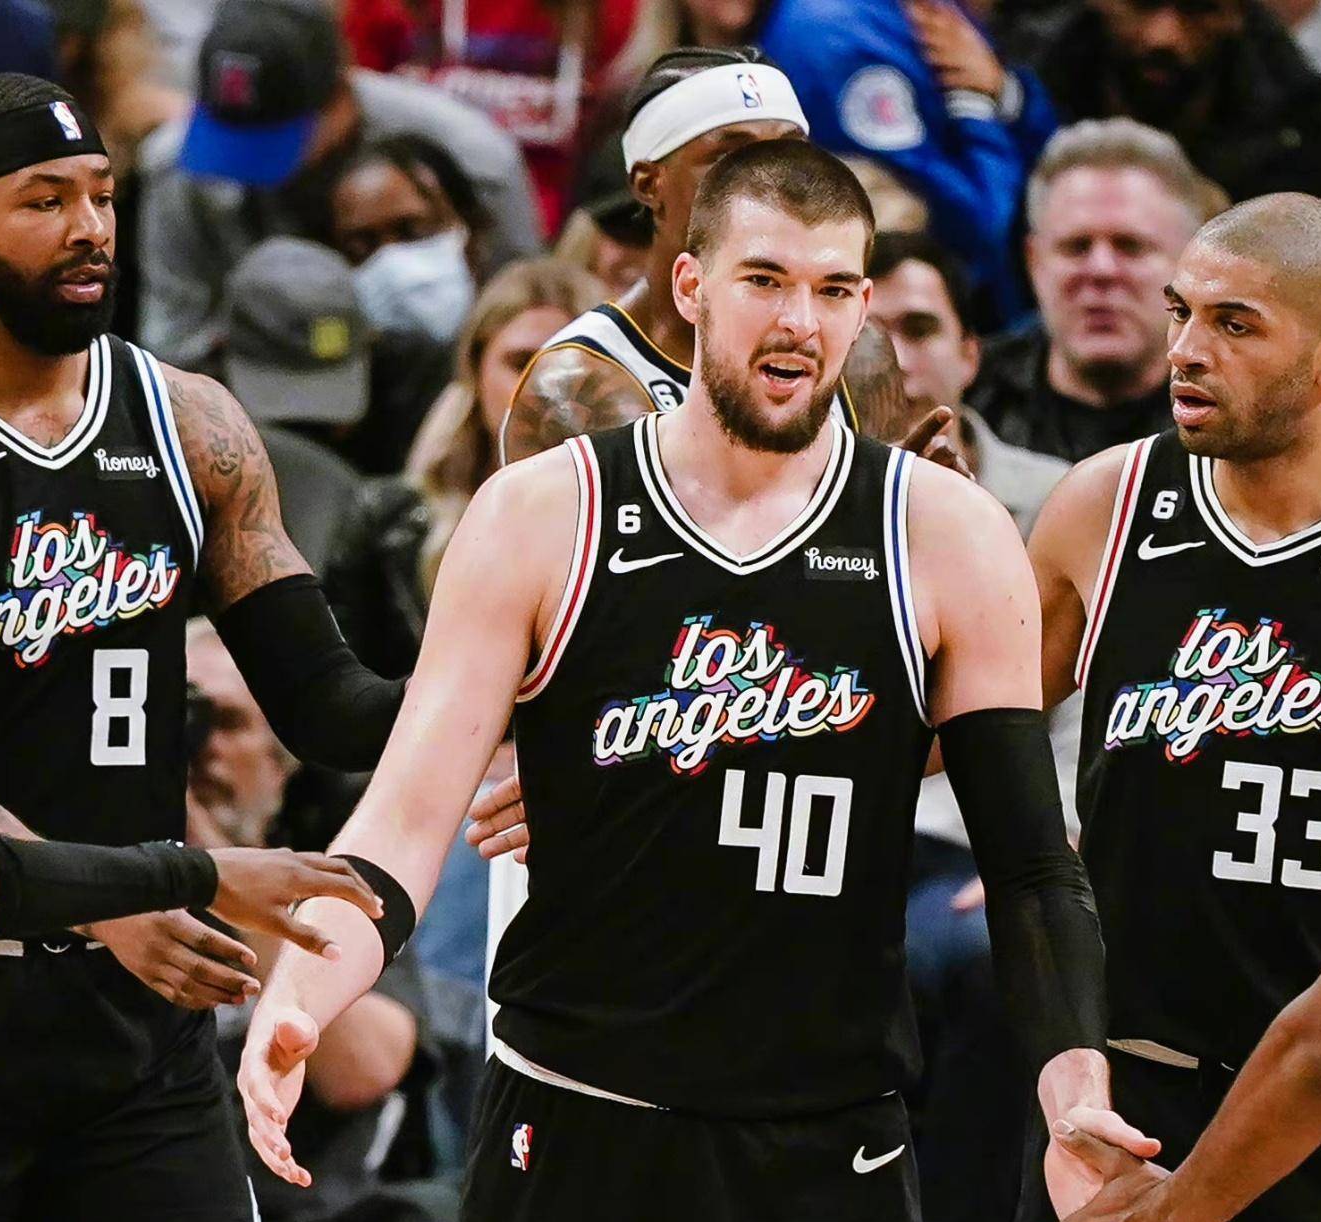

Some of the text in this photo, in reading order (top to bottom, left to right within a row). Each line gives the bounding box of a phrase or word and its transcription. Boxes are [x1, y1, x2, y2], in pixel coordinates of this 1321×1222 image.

[94, 448, 161, 478] honey
[617, 504, 641, 534] 6
[1152, 490, 1179, 519] 6
[11, 519, 108, 588] los
[804, 547, 879, 579] honey
[671, 623, 785, 689] los
[1174, 614, 1287, 679] los
[90, 649, 149, 766] 8
[594, 667, 868, 769] angeles
[718, 768, 854, 897] 40
